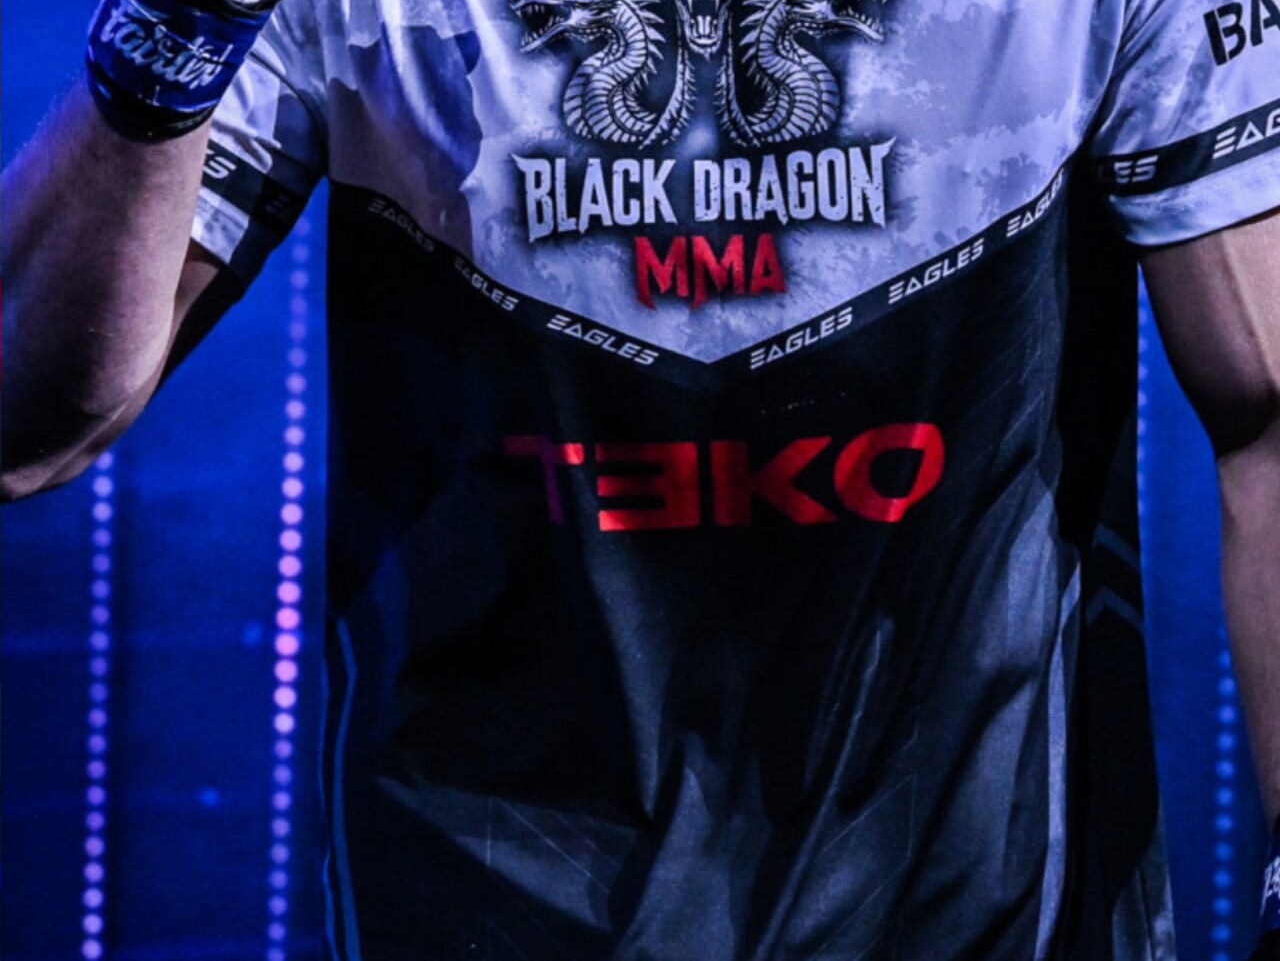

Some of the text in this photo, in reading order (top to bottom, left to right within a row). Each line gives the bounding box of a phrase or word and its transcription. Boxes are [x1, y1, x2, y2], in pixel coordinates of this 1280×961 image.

[511, 137, 897, 243] BLACK DRAGON
[454, 256, 519, 312] EAGLES
[547, 314, 659, 366] EAGLES
[750, 306, 853, 370] EAGLES
[888, 238, 985, 305] EAGLES
[634, 233, 786, 310] MMA
